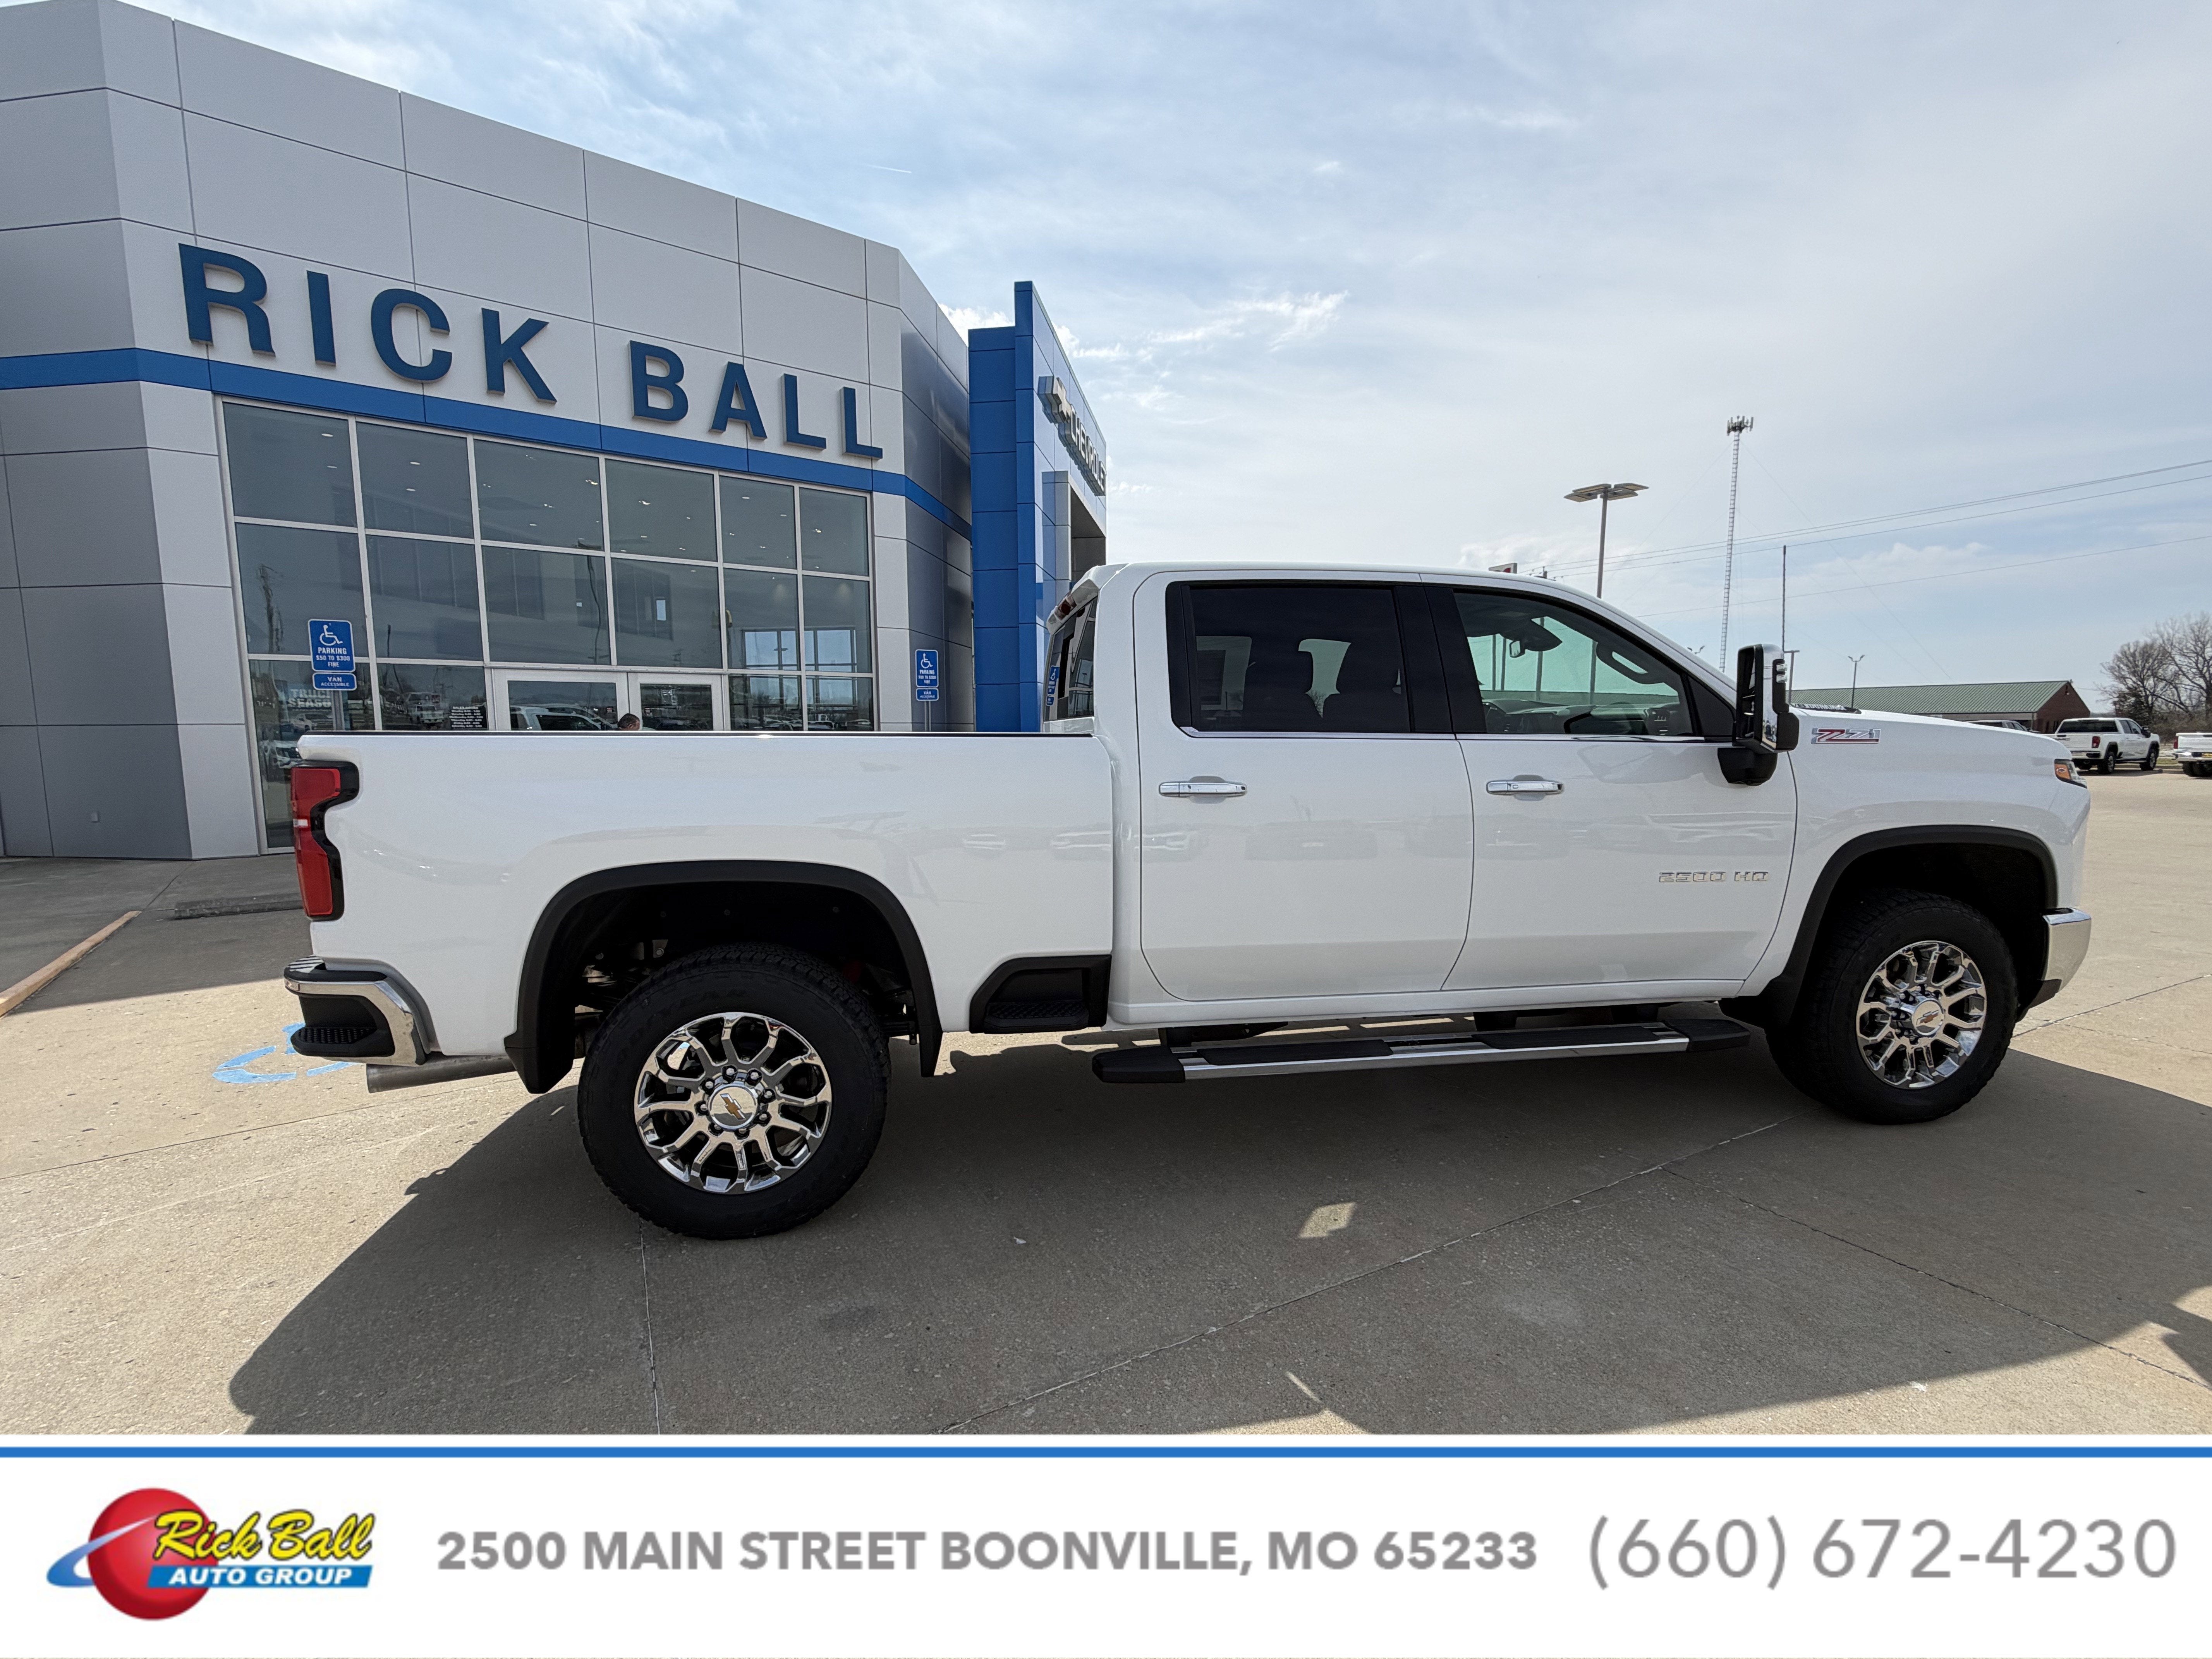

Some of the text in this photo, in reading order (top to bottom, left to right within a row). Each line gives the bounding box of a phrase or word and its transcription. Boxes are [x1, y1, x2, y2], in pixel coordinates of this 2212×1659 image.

[179, 243, 883, 460] RICK BALL
[288, 698, 331, 708] SEASO
[1812, 728, 1881, 744] Z71
[1659, 871, 1769, 882] 2500 HD
